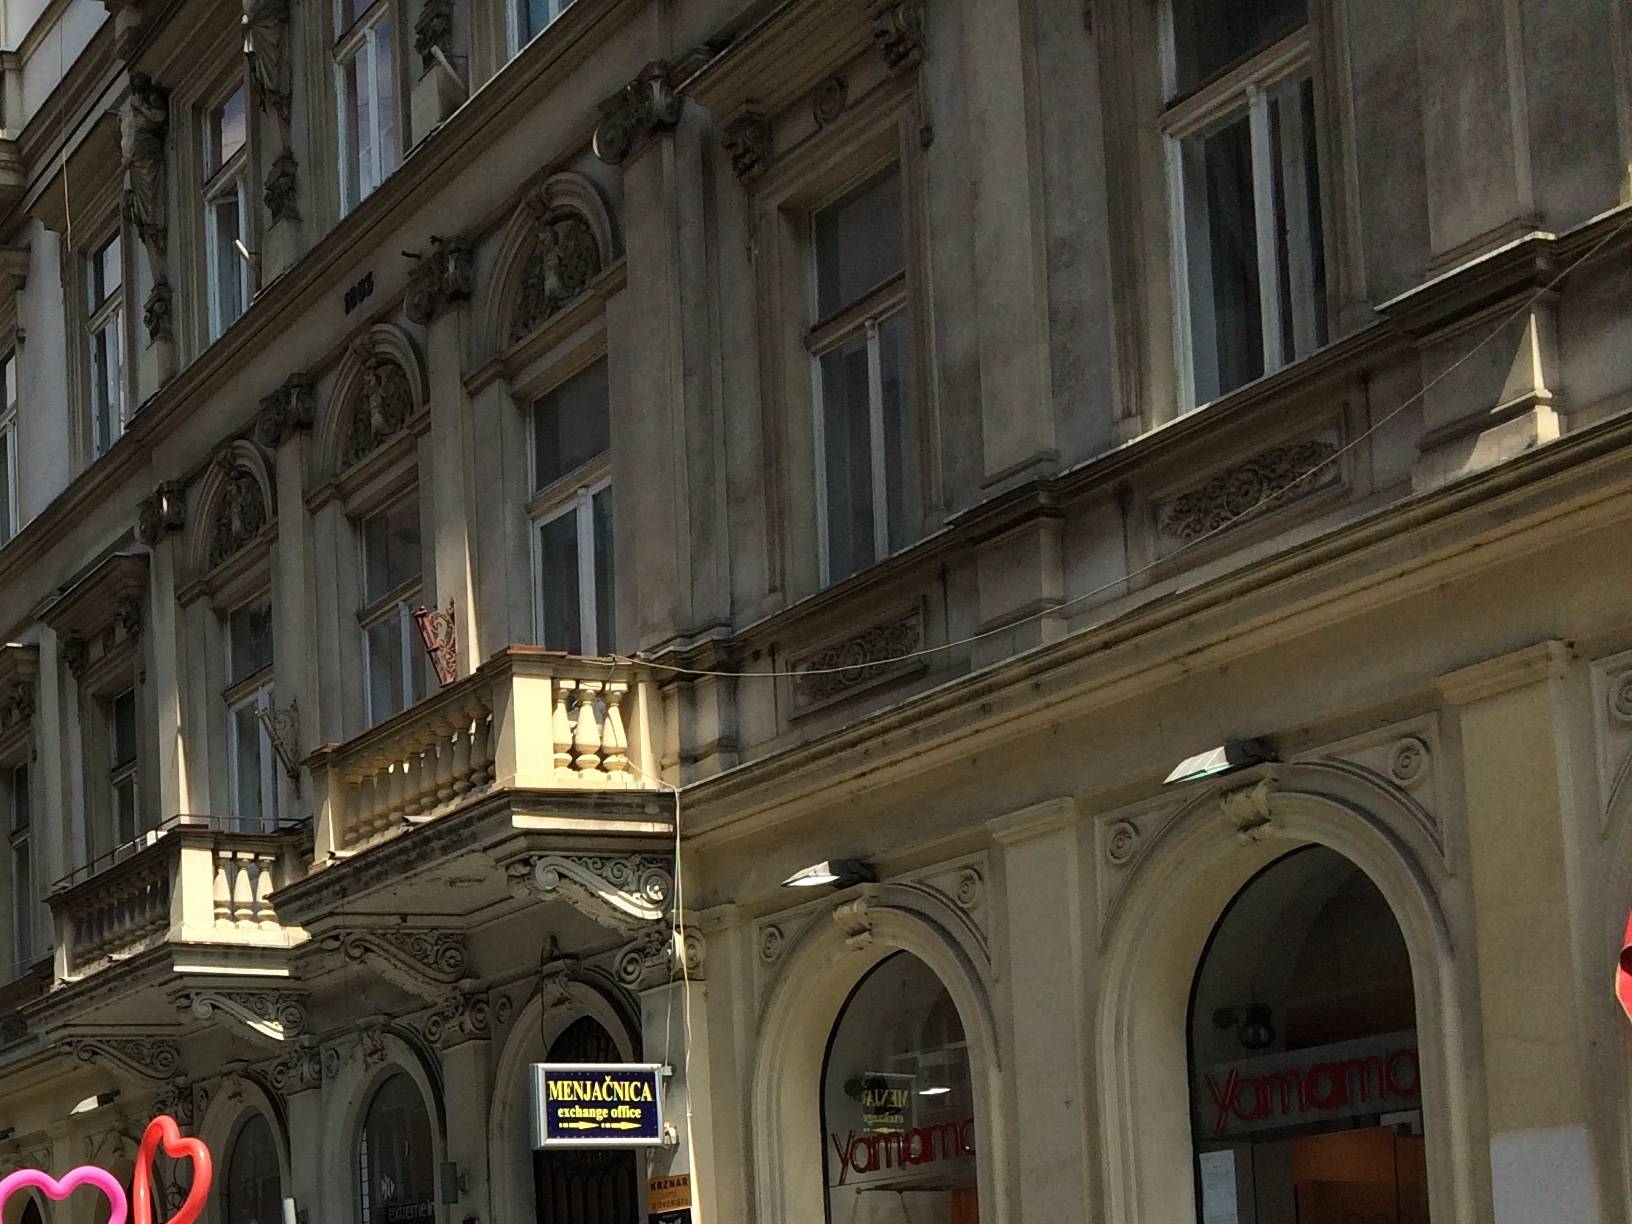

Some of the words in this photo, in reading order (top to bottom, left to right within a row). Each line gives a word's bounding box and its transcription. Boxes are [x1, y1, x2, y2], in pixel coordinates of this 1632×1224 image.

[547, 1075, 653, 1102] MENJAČNICA
[557, 1105, 609, 1121] exchange
[610, 1105, 642, 1119] office
